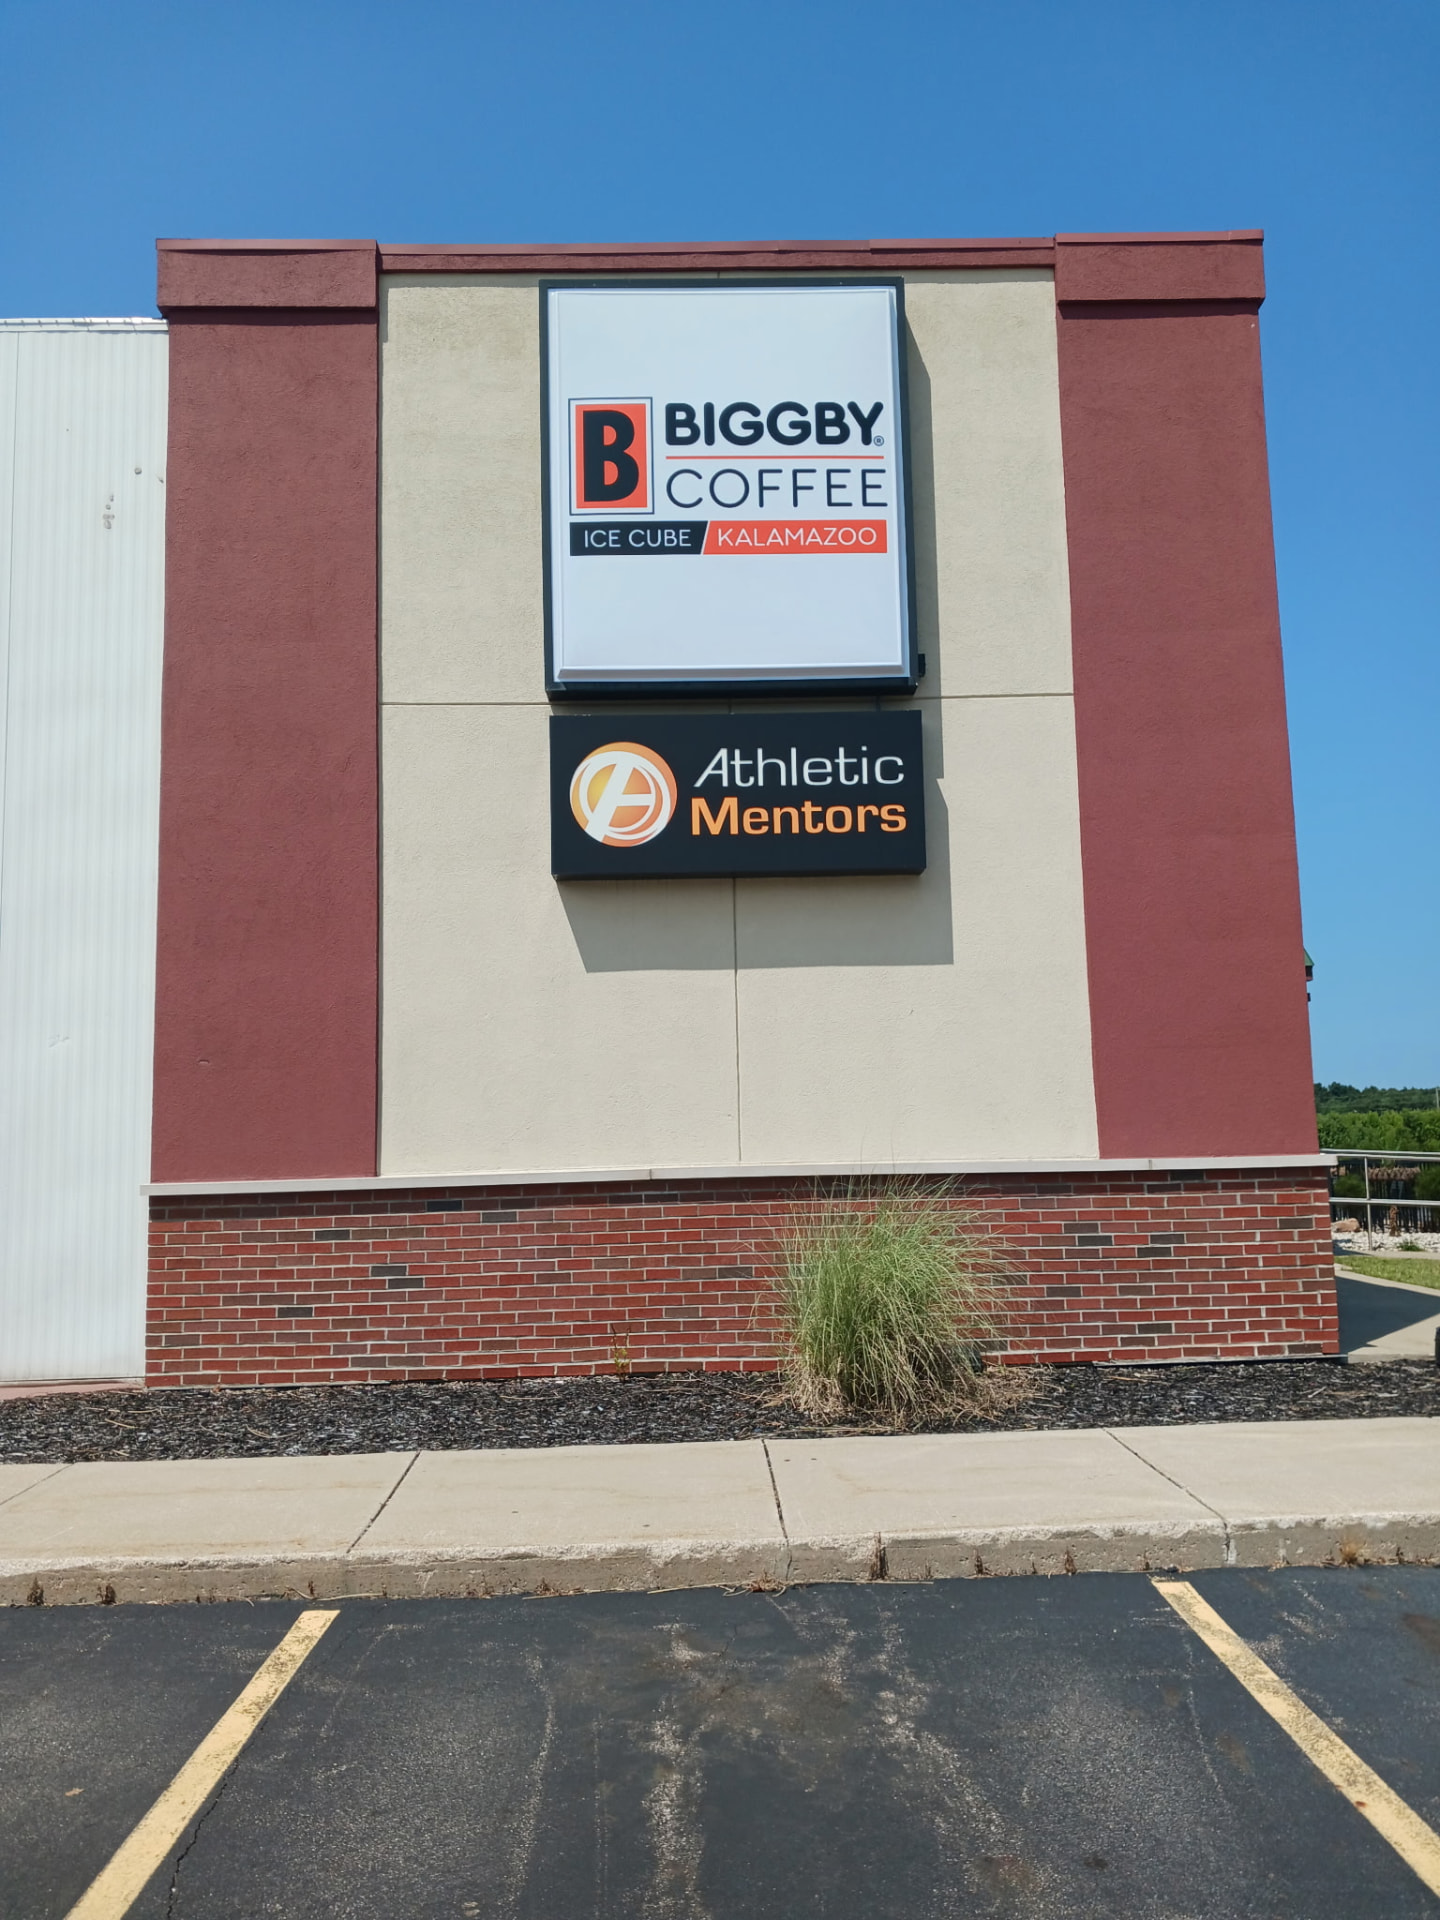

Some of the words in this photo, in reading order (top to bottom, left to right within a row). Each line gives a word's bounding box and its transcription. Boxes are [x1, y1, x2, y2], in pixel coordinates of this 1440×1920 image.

[582, 409, 640, 503] B
[666, 468, 888, 509] COFFEE
[584, 529, 621, 548] ICE
[628, 528, 692, 548] CUBE
[717, 526, 877, 548] KALAMAZOO
[693, 745, 905, 788] Athletic
[690, 796, 907, 836] Mentors
